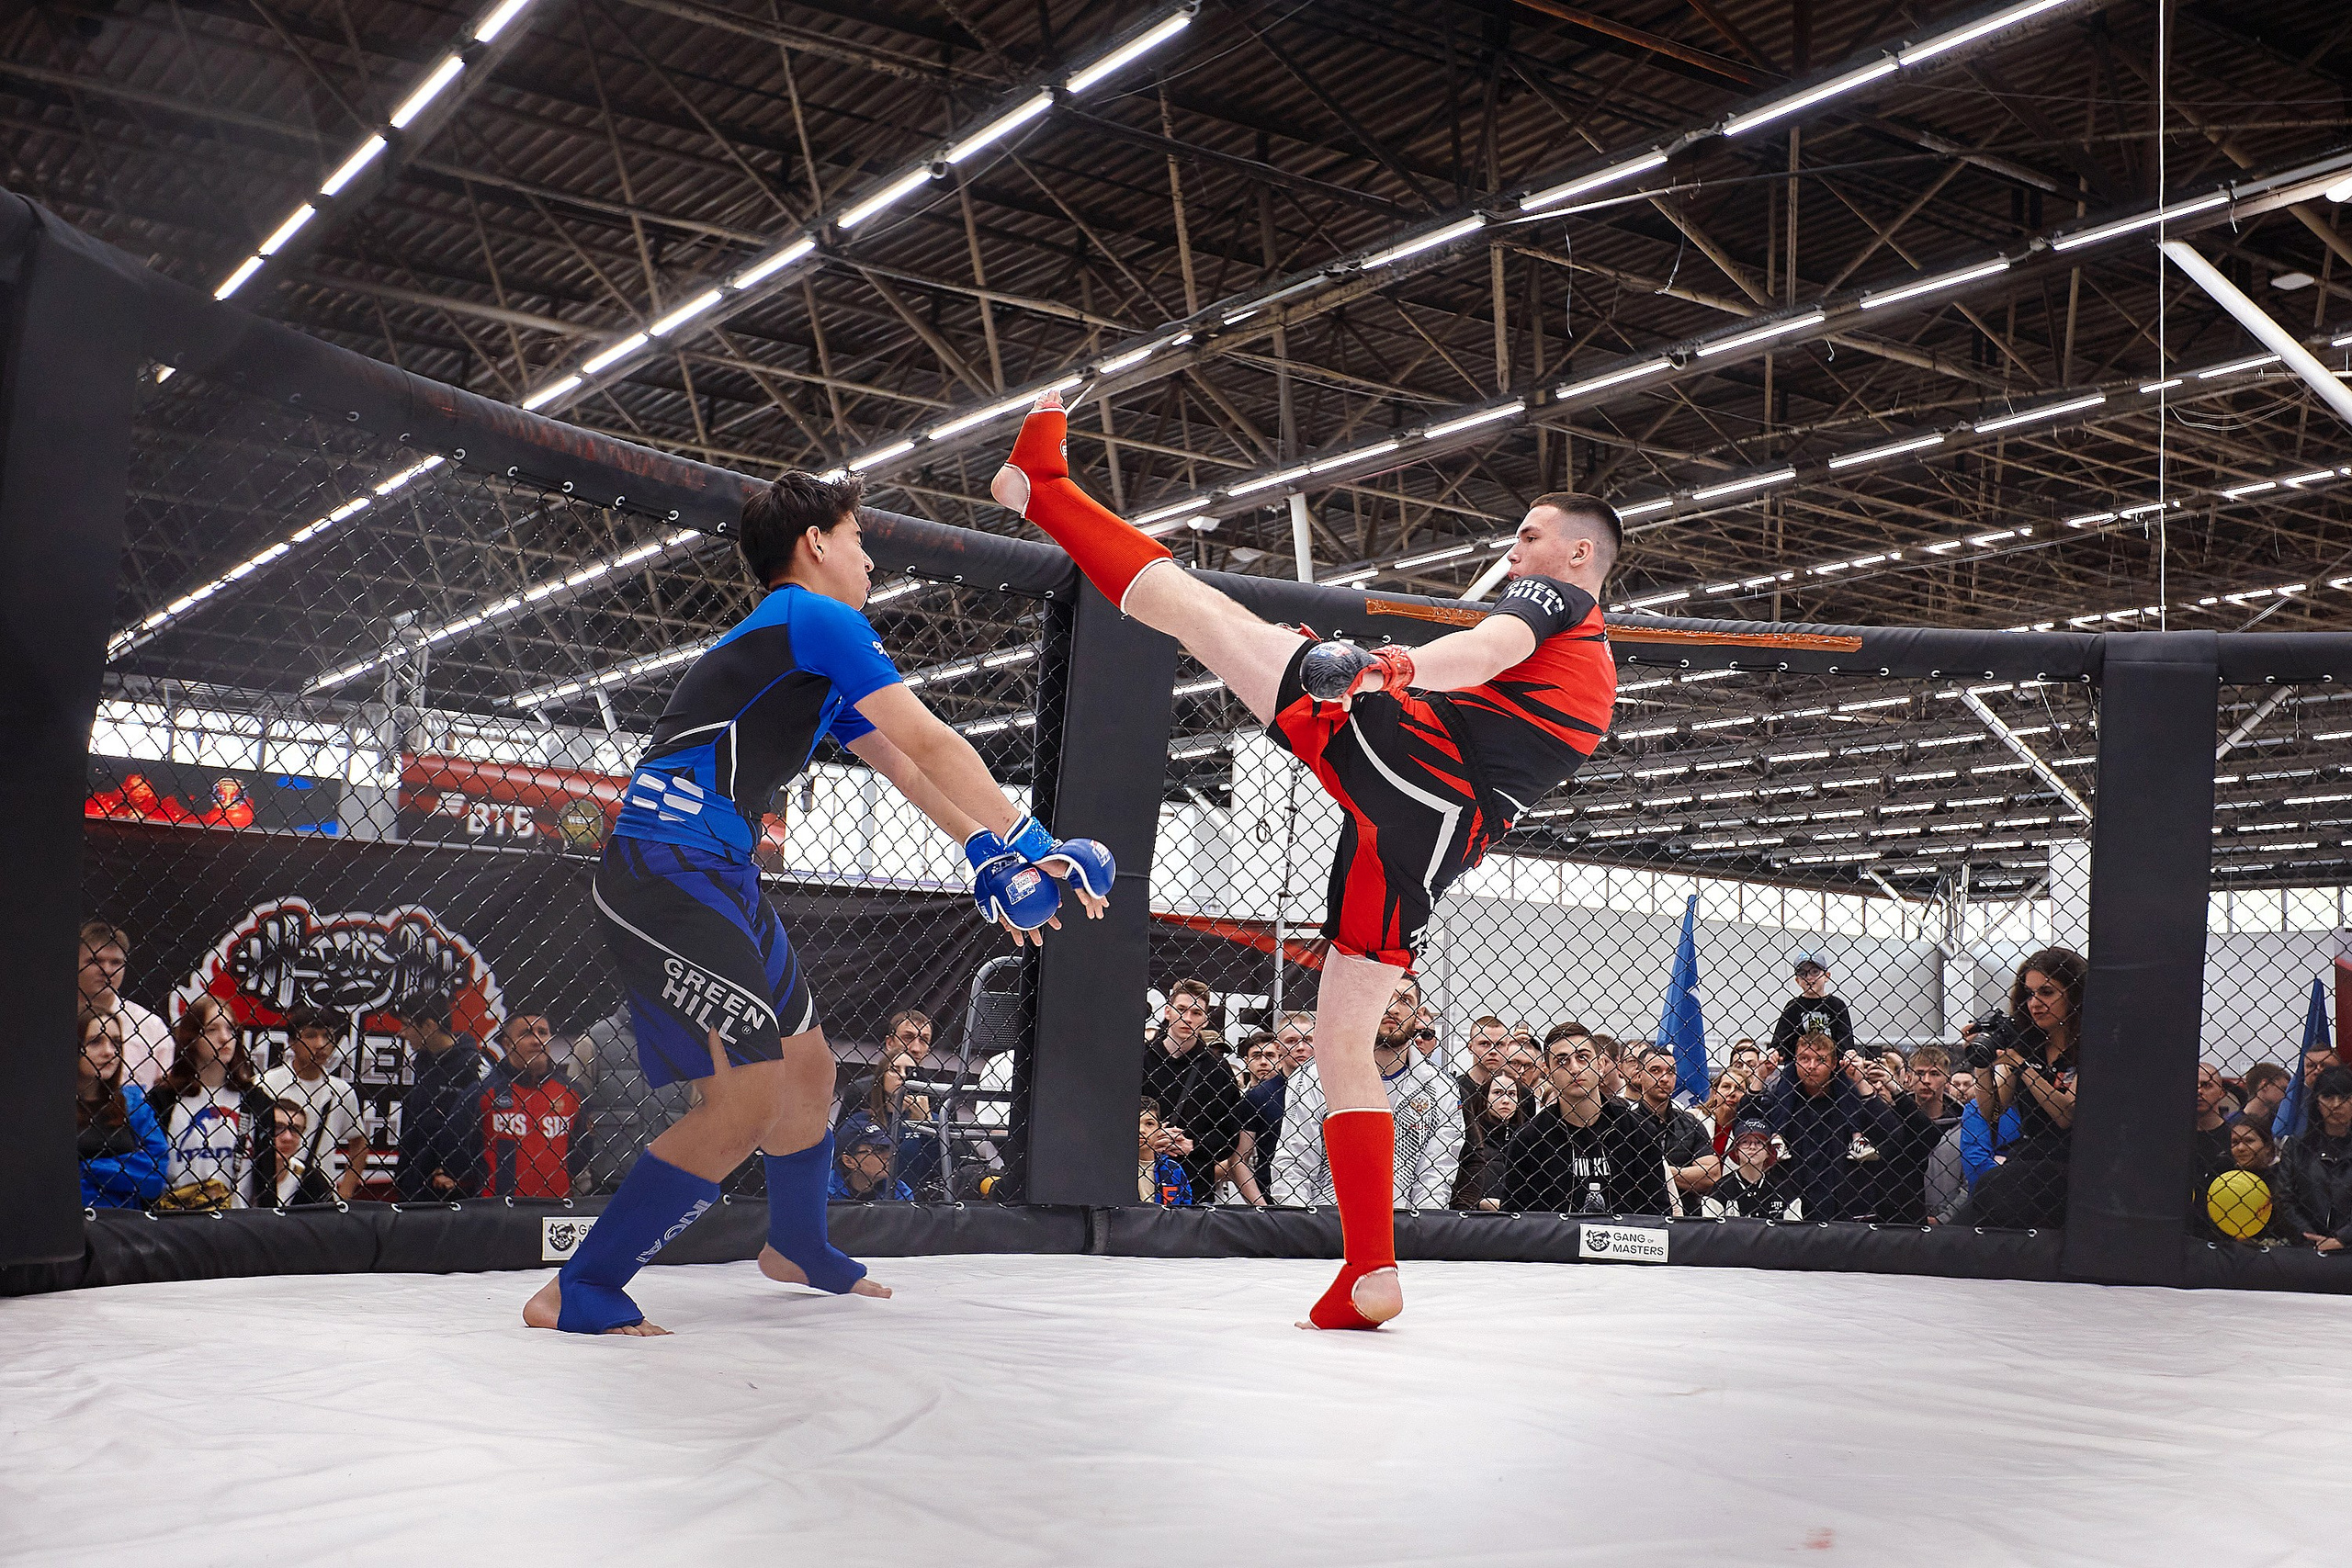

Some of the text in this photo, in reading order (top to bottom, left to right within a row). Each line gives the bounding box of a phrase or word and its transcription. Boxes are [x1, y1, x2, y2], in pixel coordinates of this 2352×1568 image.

[1507, 587, 1553, 616] HILL
[663, 957, 766, 1030] GREEN
[662, 977, 738, 1044] HILL
[1612, 1244, 1664, 1256] MASTERS
[1613, 1232, 1645, 1243] GANG
